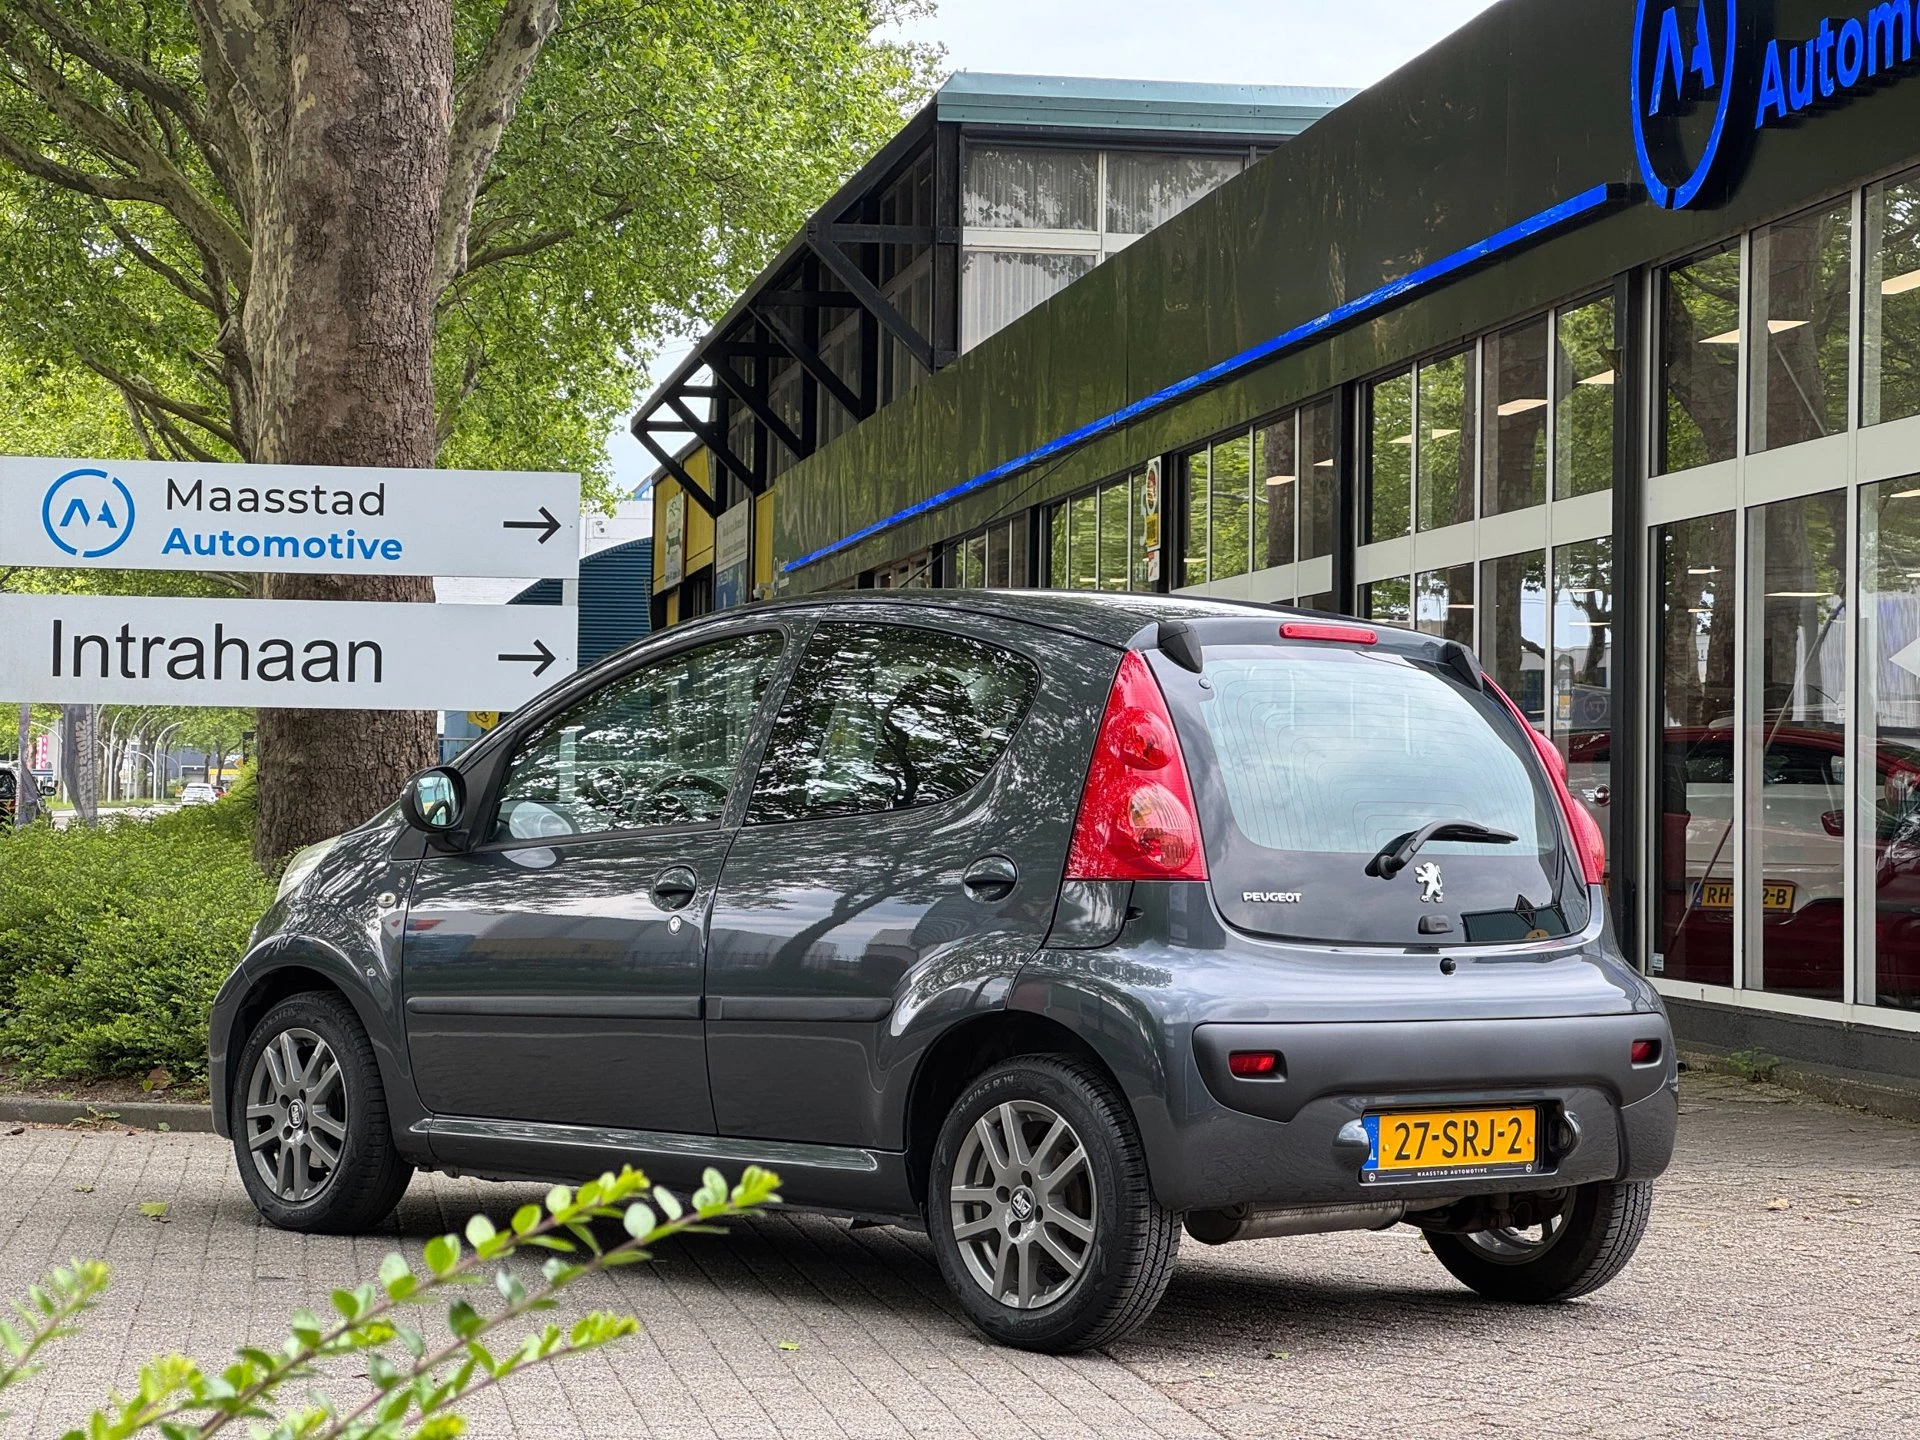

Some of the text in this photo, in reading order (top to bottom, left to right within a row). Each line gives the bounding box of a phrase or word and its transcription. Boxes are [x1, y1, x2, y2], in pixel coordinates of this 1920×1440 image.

[1755, 0, 1920, 129] Autom
[166, 478, 386, 516] Maasstad
[162, 527, 403, 561] Automotive
[52, 619, 383, 684] Intrahaan
[1242, 891, 1302, 903] PEUGEOT
[1394, 1116, 1523, 1161] 27-SRJ-2
[1416, 1167, 1488, 1177] MAASSTAD AUTOMOTIVE
